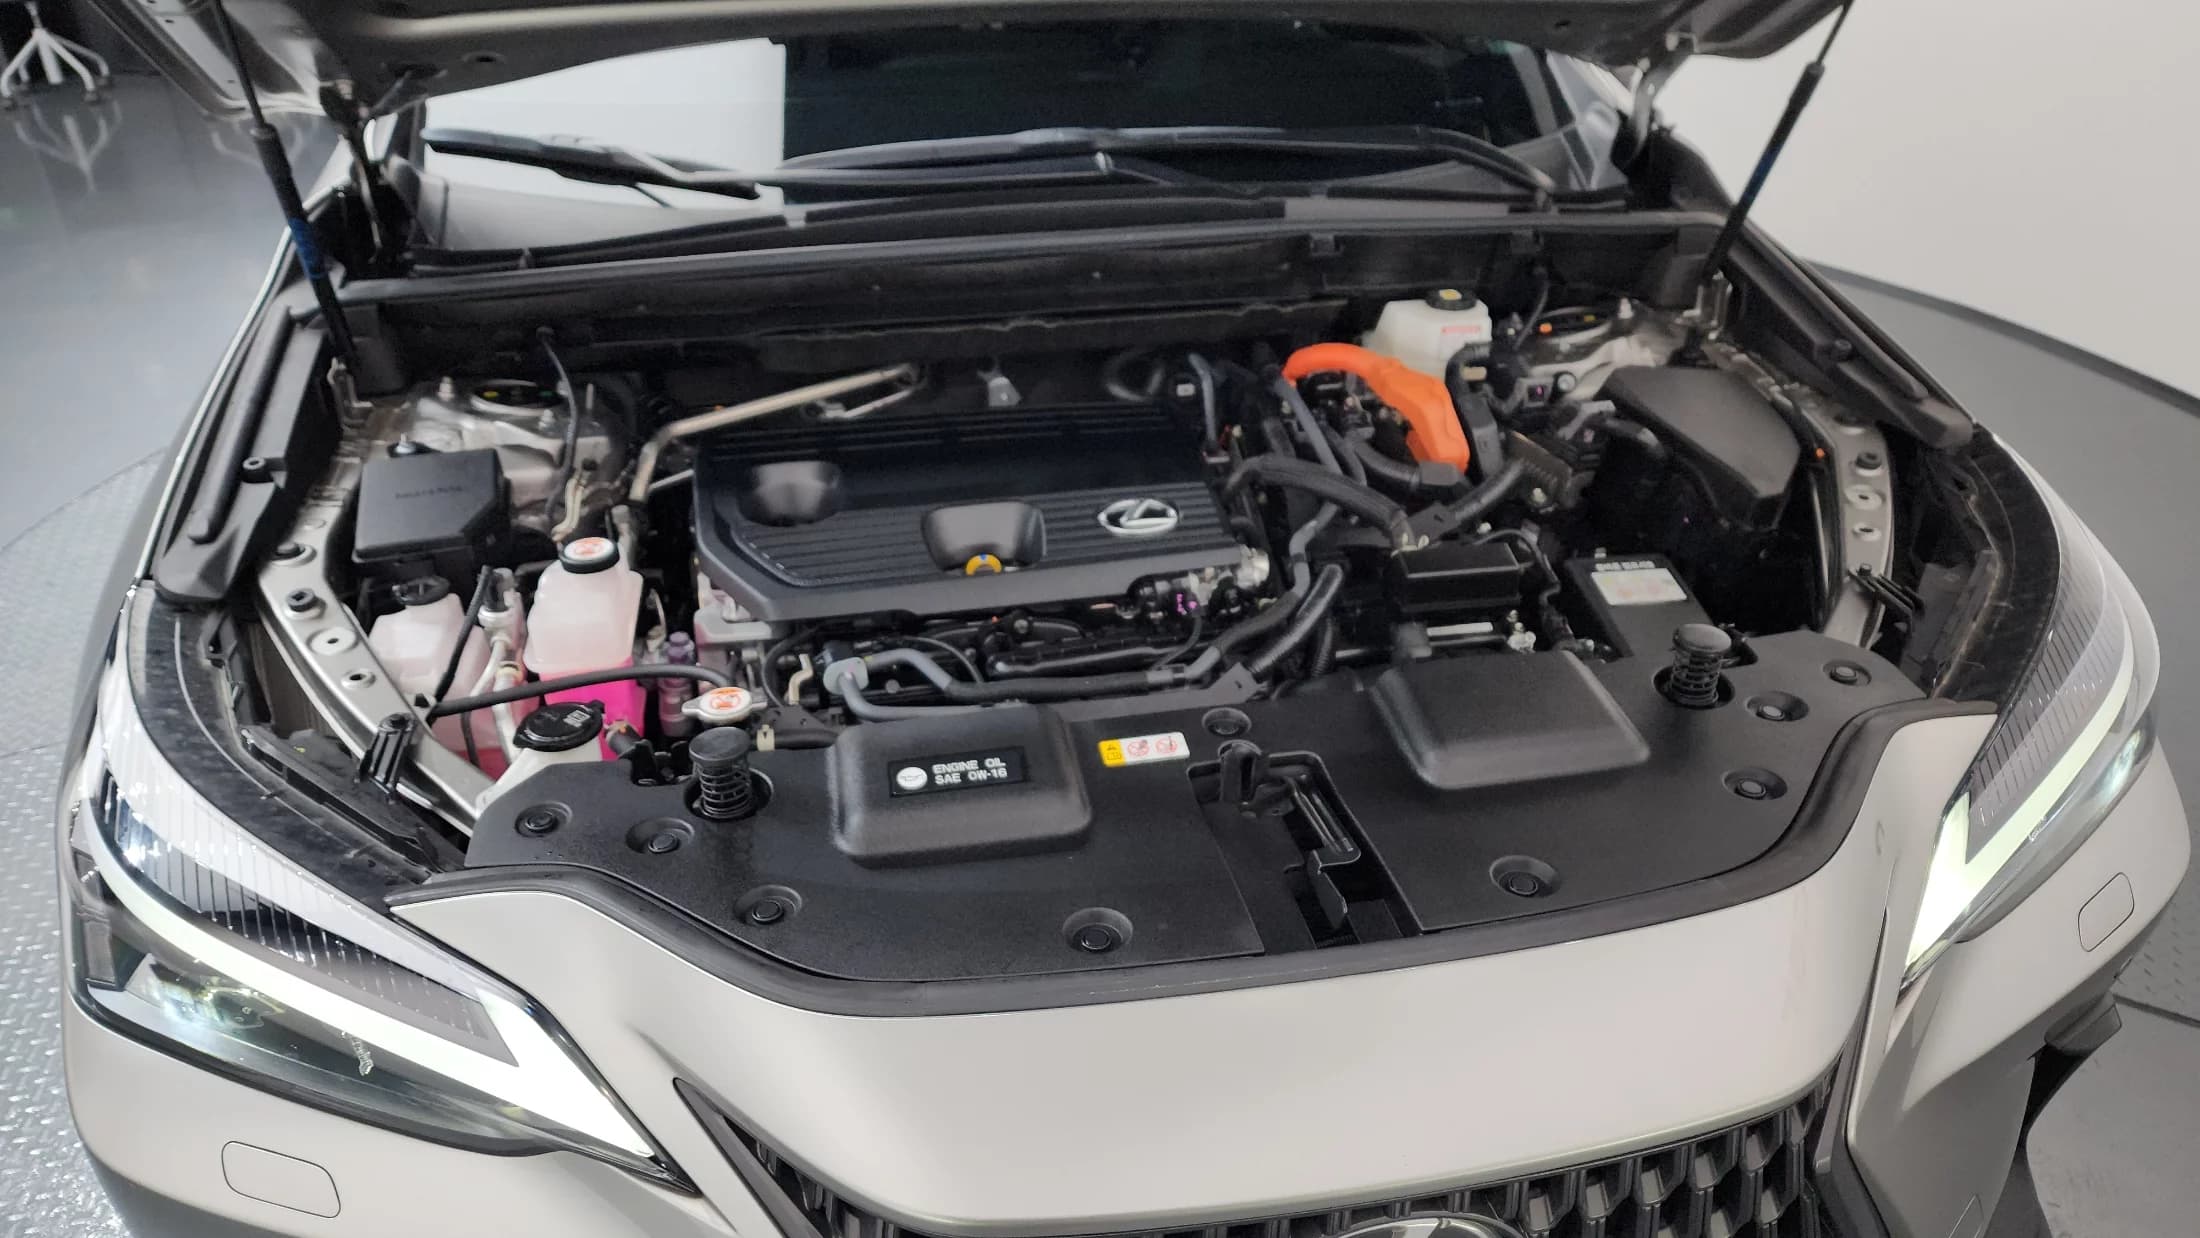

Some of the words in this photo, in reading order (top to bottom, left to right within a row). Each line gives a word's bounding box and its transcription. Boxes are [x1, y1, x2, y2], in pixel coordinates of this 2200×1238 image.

[932, 759, 978, 774] ENGINE
[985, 757, 1007, 769] OIL
[934, 772, 961, 785] SAE
